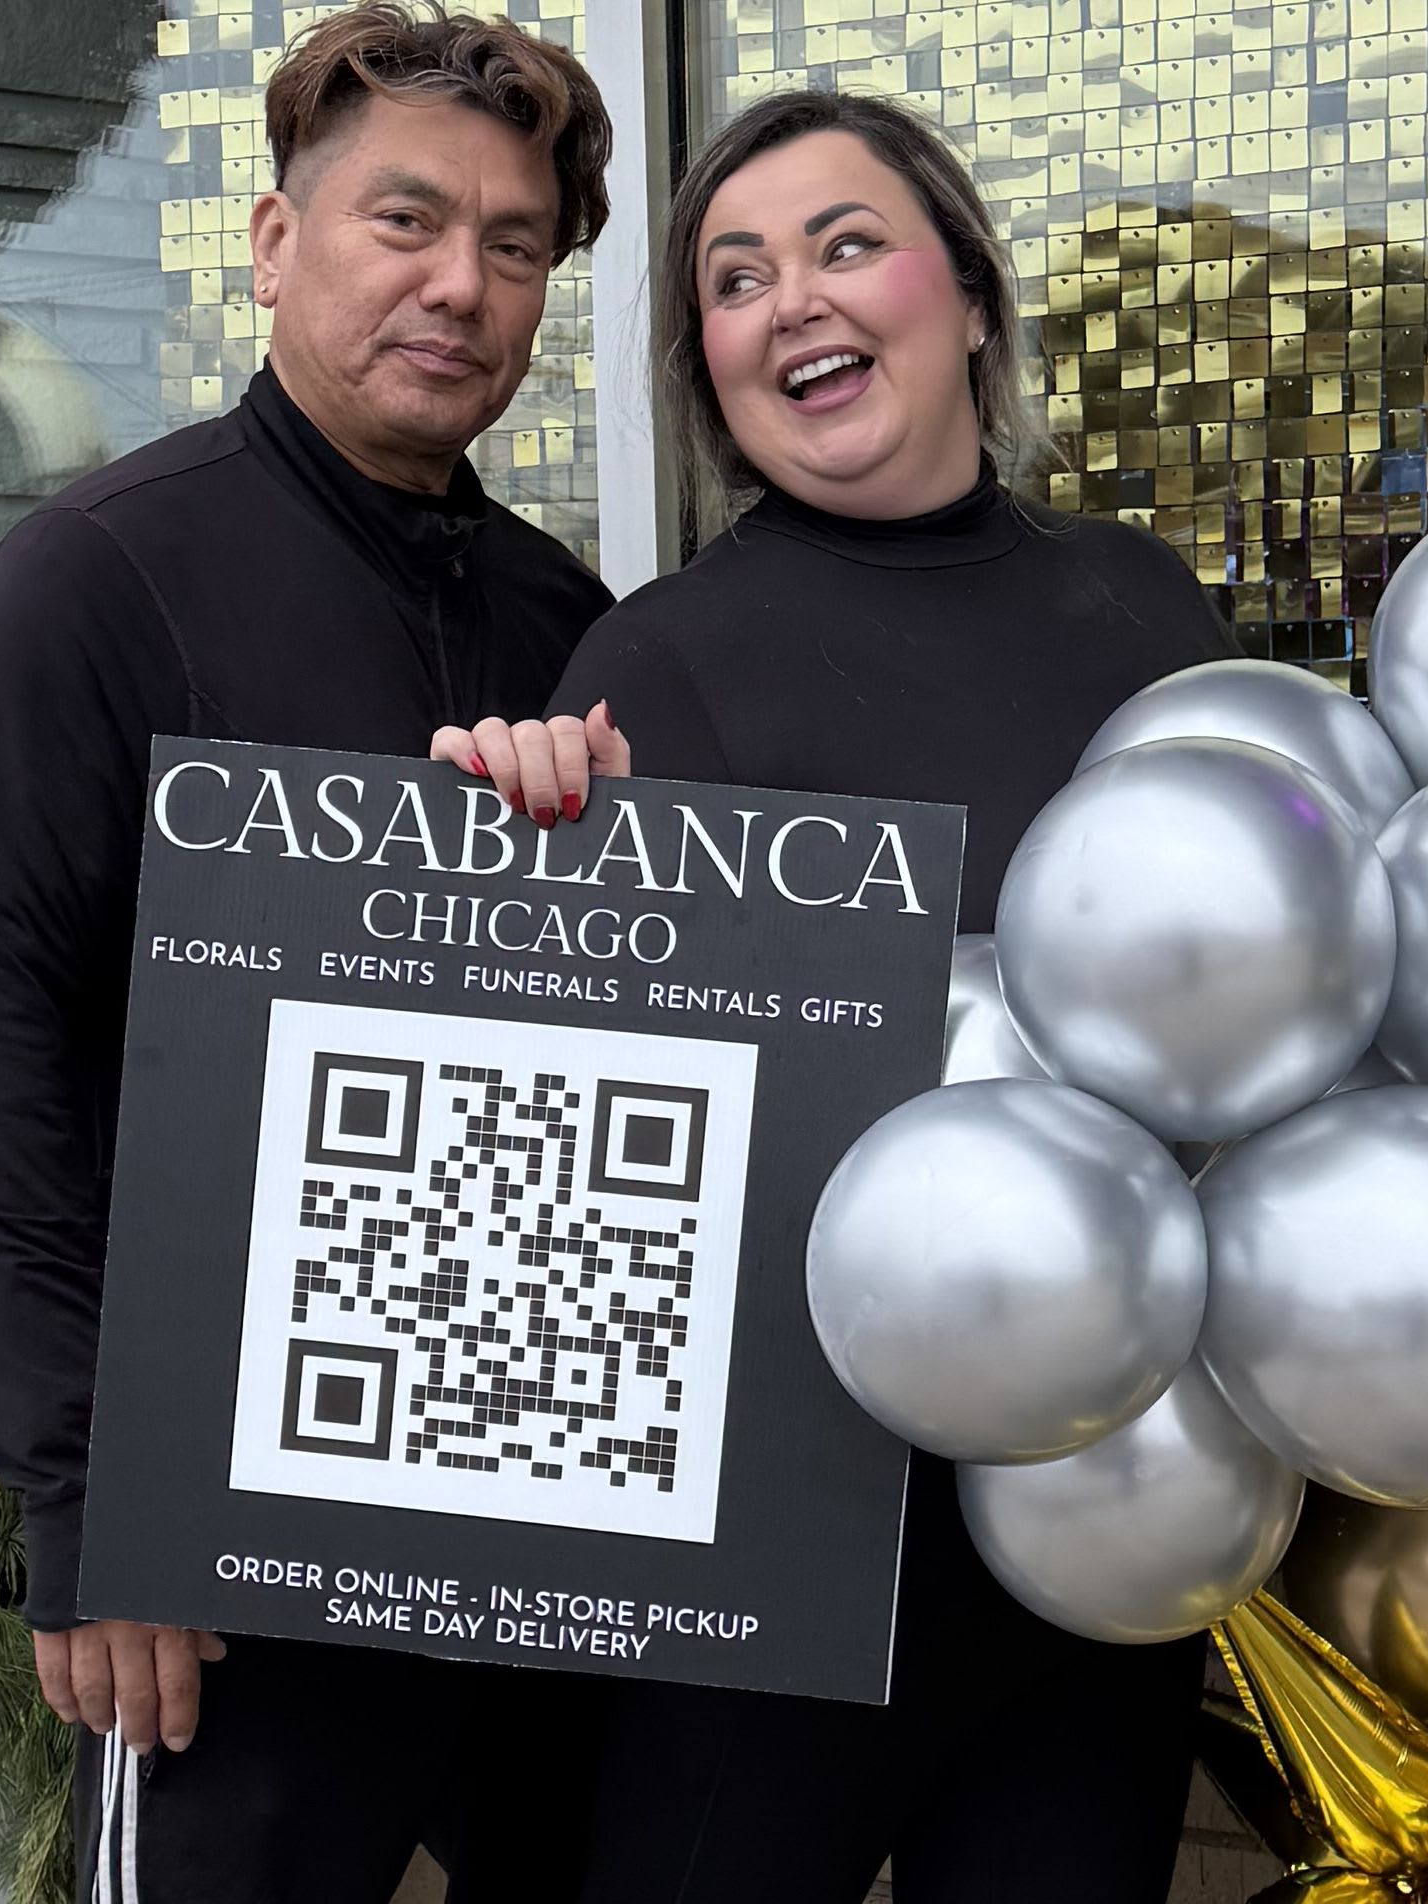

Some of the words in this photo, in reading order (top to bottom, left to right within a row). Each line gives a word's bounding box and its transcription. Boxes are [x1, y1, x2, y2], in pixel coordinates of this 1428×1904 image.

[153, 761, 929, 915] CASABLANCA
[361, 888, 677, 964] CHICAGO
[151, 936, 283, 971] FLORALS
[320, 952, 435, 985] EVENTS
[463, 965, 619, 1003] FUNERALS
[647, 982, 781, 1018] RENTALS
[800, 997, 883, 1028] GIFTS
[215, 1554, 323, 1590] ORDER
[334, 1567, 460, 1606] ONLINE
[490, 1585, 636, 1627] IN-STORE
[647, 1604, 759, 1641] PICKUP
[325, 1598, 412, 1632] SAME
[423, 1609, 485, 1640] DAY
[495, 1617, 650, 1660] DELIVERY
